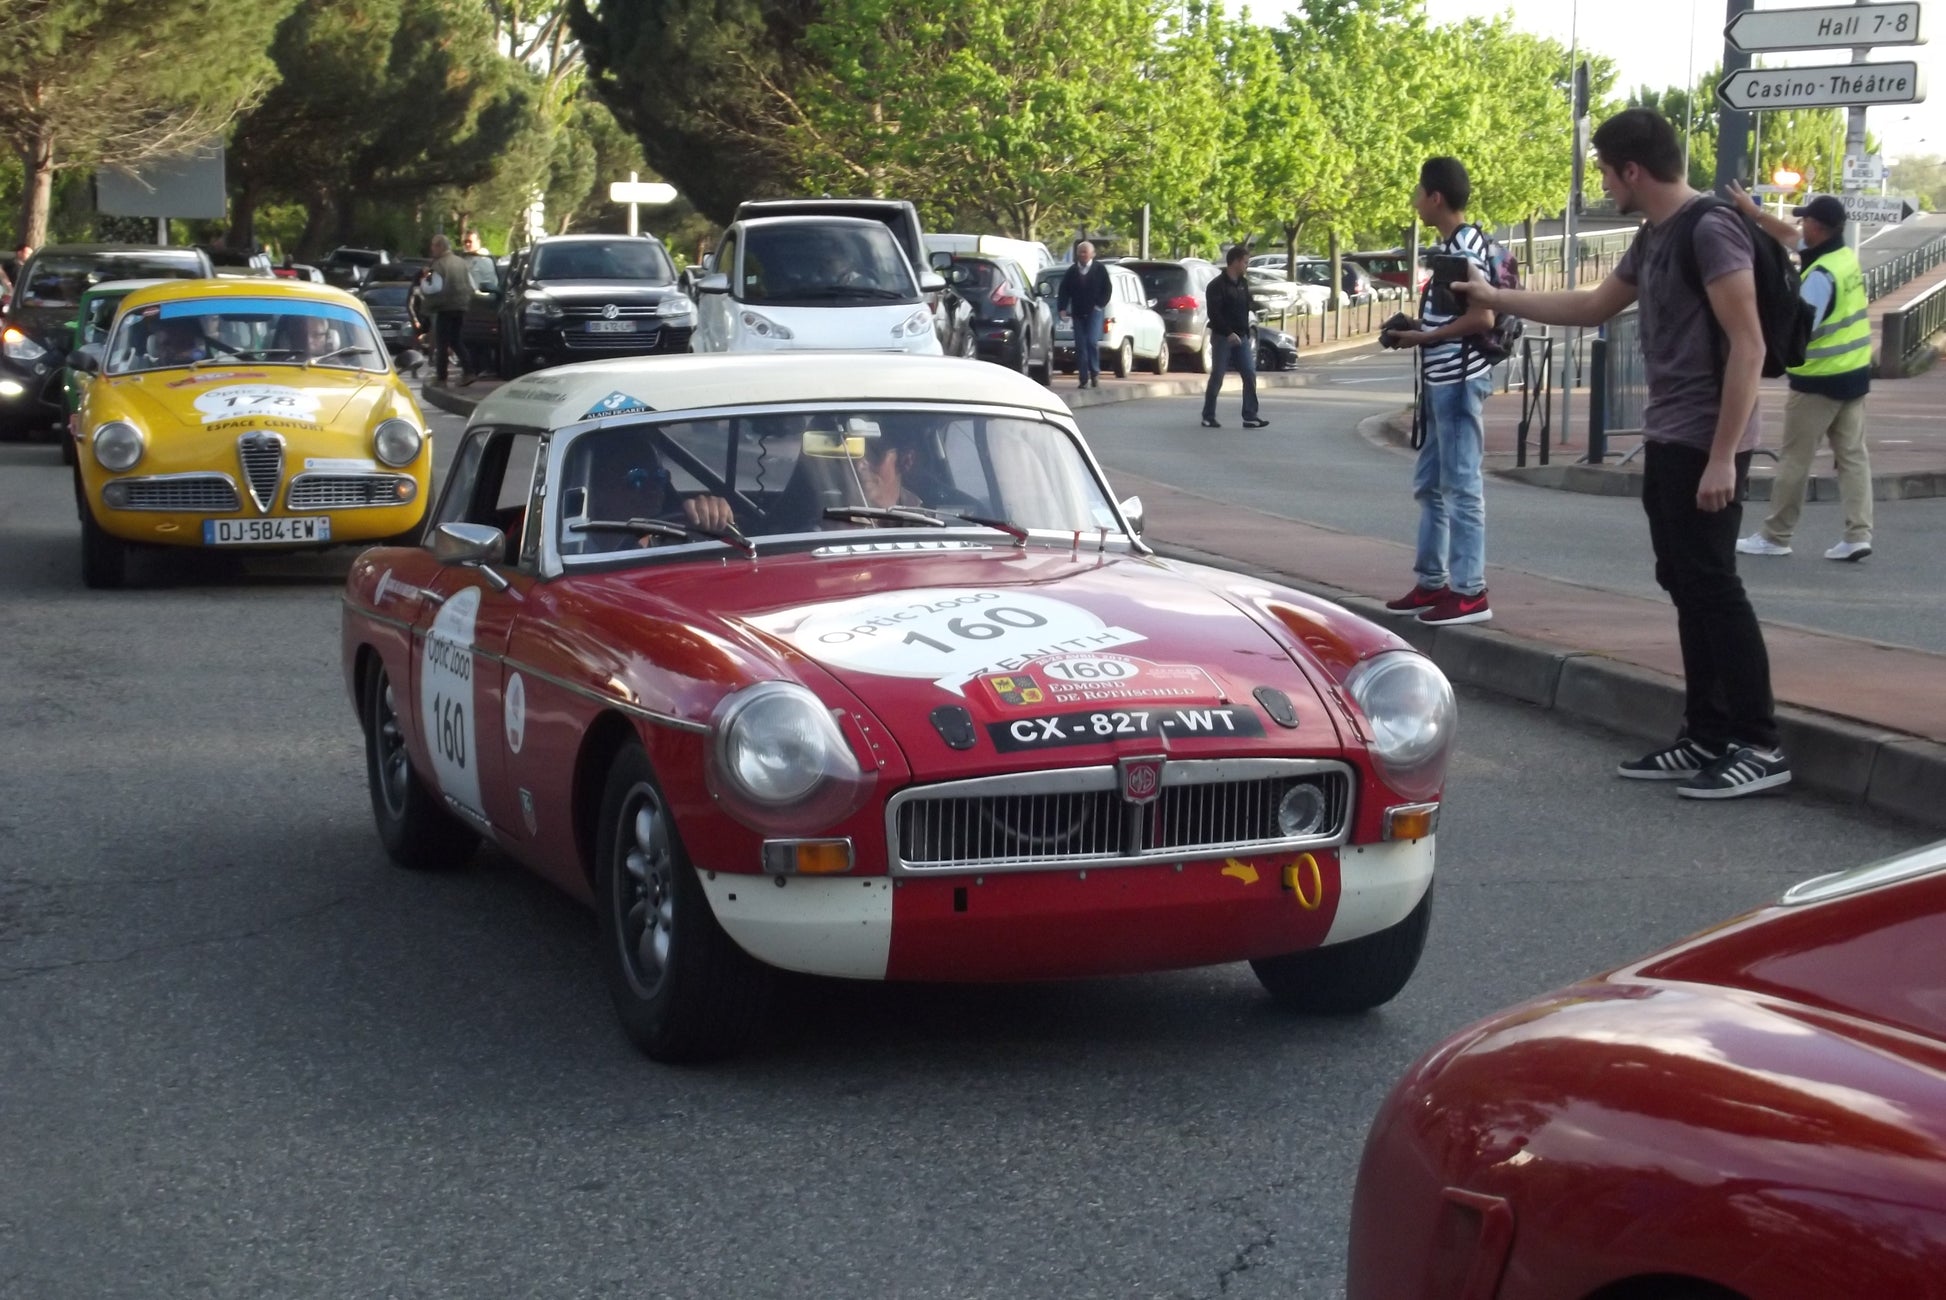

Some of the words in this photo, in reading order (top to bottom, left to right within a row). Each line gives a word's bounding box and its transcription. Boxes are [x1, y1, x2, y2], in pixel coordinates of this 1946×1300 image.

[1817, 16, 1860, 36] Hall
[1873, 13, 1909, 34] 7-8
[1746, 75, 1907, 99] Casino-Théâtre
[1857, 197, 1879, 210] Optic
[1845, 211, 1898, 223] ASSISTANCE
[224, 395, 296, 407] 178
[603, 394, 626, 409] 3
[586, 411, 612, 420] ALAIN
[206, 420, 255, 431] ESPACE
[264, 420, 325, 432] CENTURY
[219, 520, 315, 541] DJ-584-EW
[818, 611, 918, 644] Optic
[908, 592, 1000, 614] 2000
[902, 606, 1048, 654] 160
[428, 630, 449, 674] Optic
[449, 643, 470, 681] 2000
[1053, 661, 1125, 679] 160
[1049, 680, 1126, 693] EDMOND
[1055, 694, 1081, 703] DE
[1083, 687, 1196, 700] ROTHSCHILD
[433, 691, 466, 770] 160
